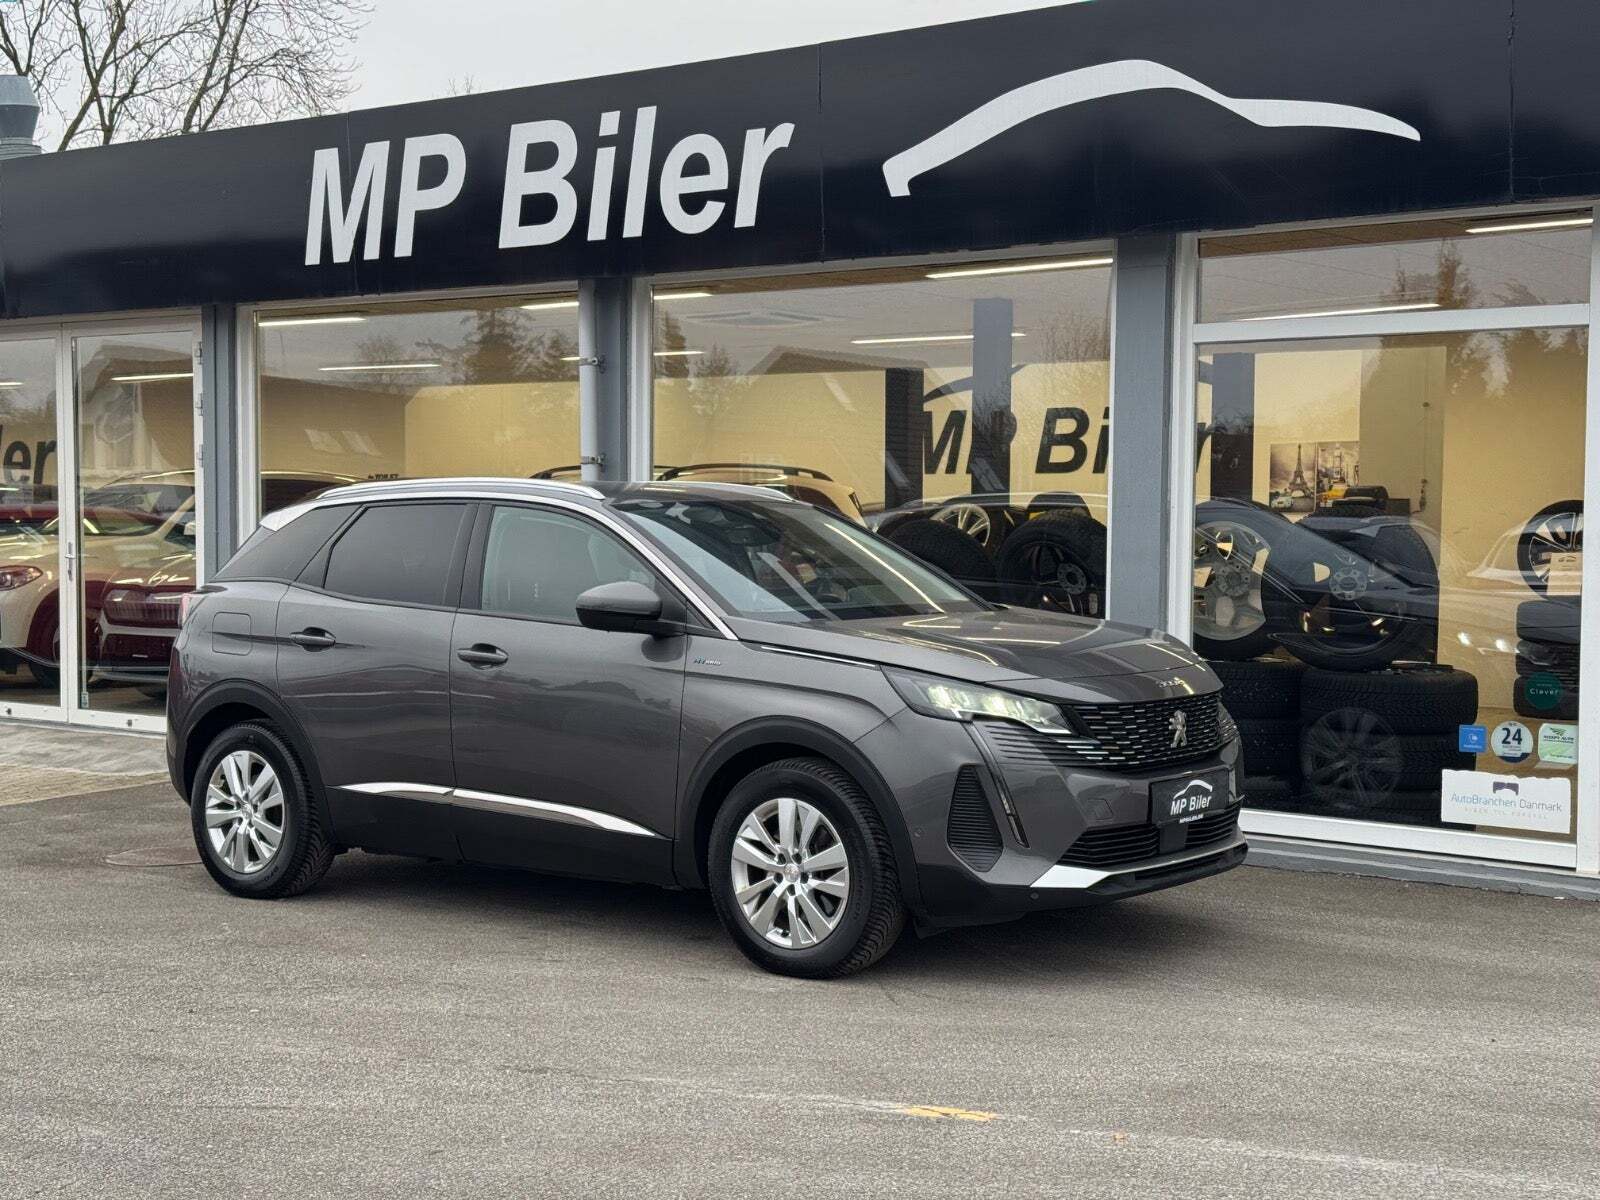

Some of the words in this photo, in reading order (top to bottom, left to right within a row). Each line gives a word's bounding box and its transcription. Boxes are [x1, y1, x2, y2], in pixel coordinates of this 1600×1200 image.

[305, 133, 467, 266] MP
[499, 105, 795, 249] Biler
[1529, 687, 1559, 696] Clever
[1501, 727, 1523, 745] 24
[1170, 798, 1187, 816] MP
[1188, 794, 1213, 812] Biler
[1451, 793, 1517, 808] AutoBranchen
[1519, 799, 1563, 813] Danmark
